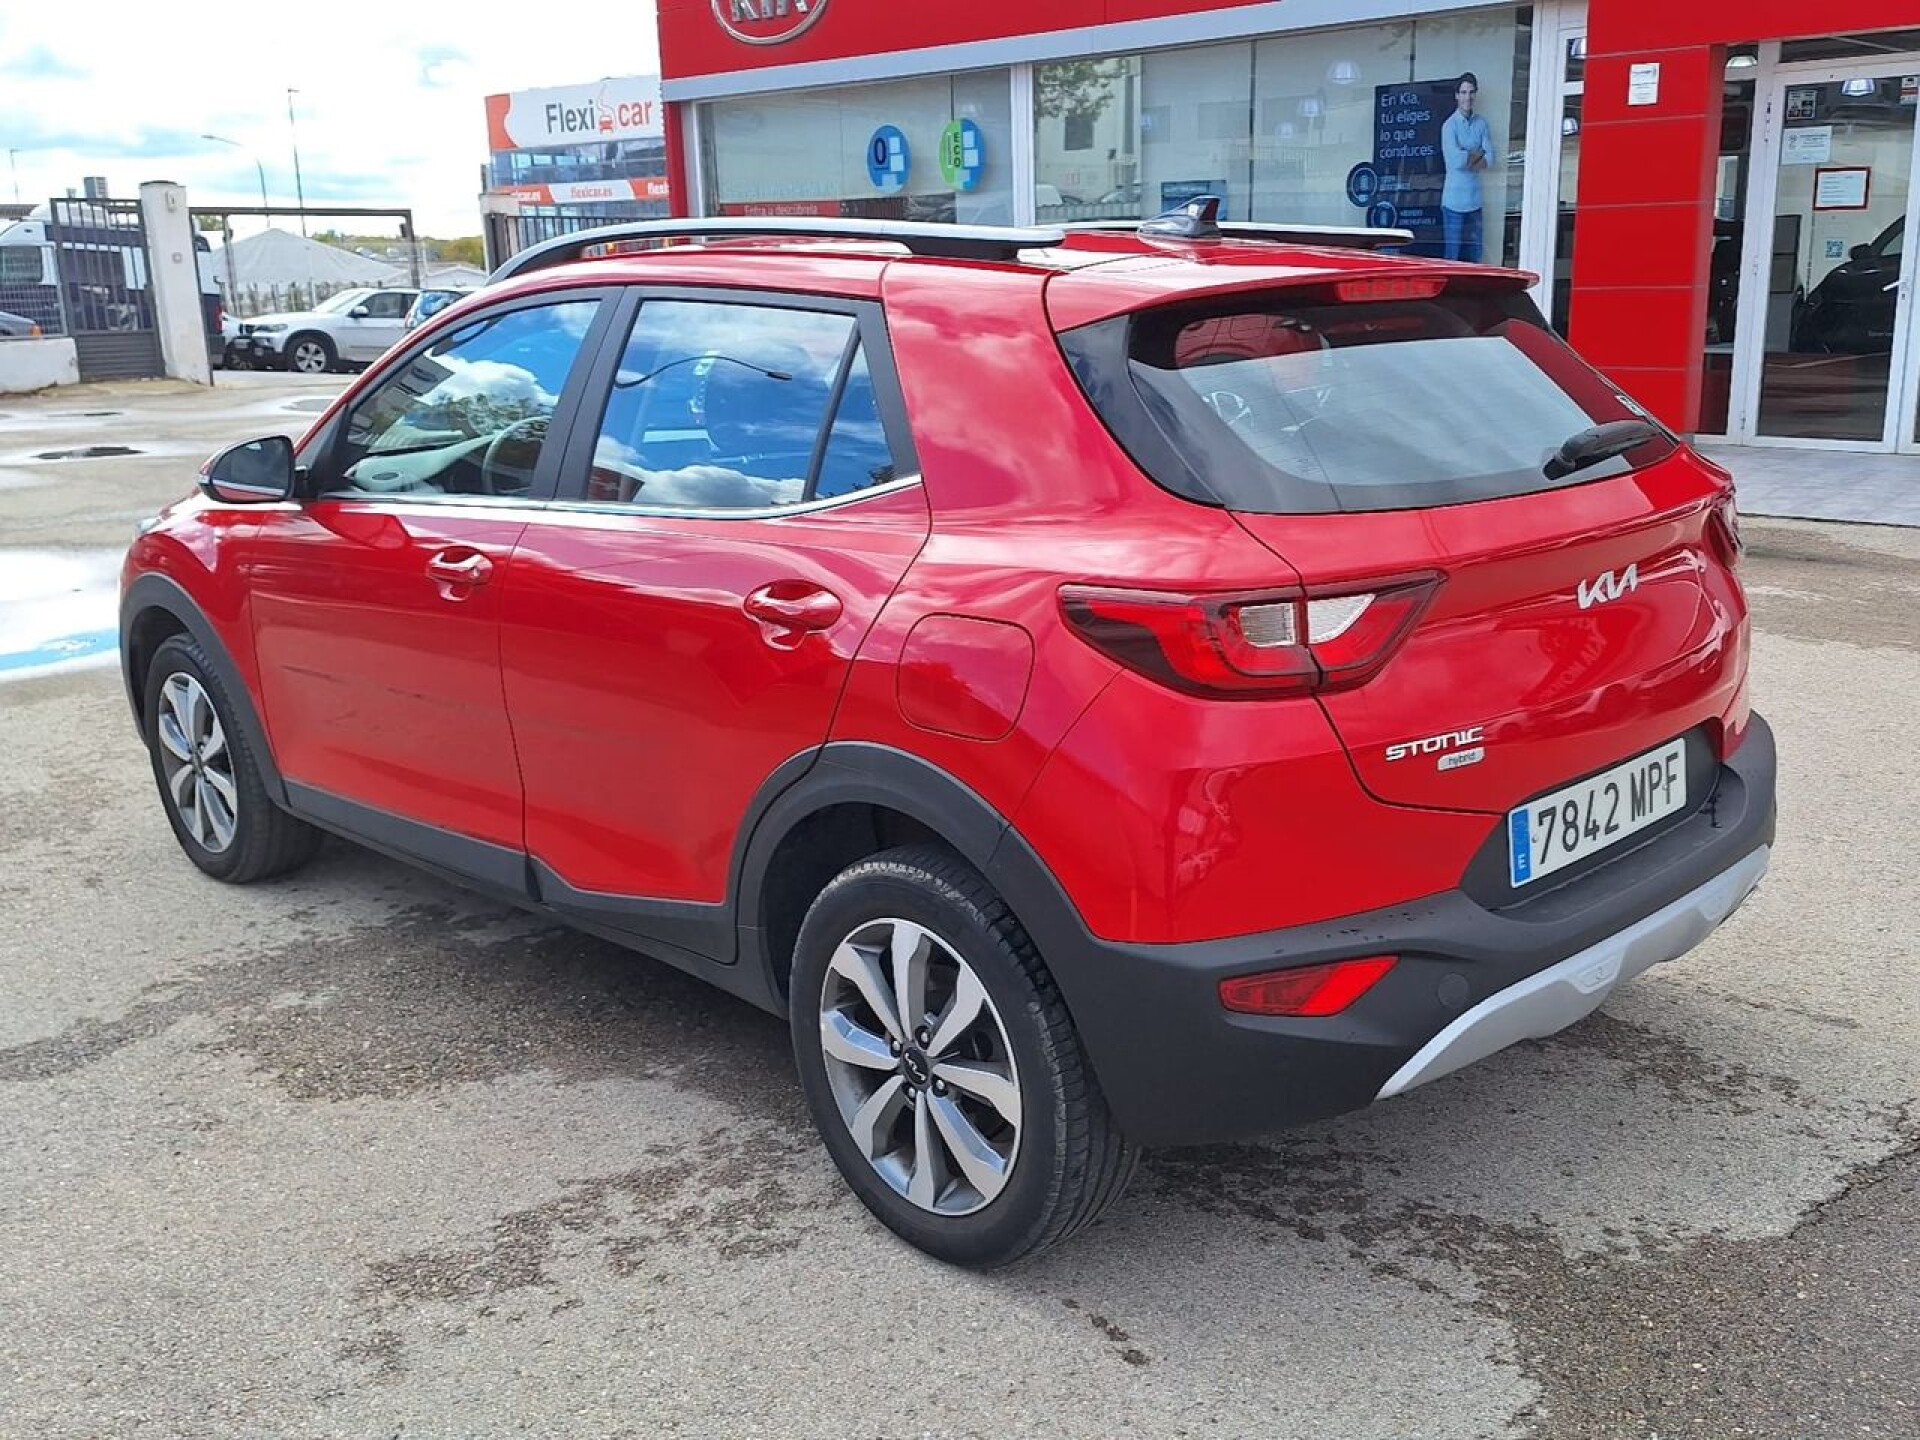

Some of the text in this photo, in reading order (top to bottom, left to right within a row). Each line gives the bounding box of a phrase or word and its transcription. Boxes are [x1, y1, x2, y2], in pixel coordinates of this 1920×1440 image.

[545, 98, 652, 133] Flexi car
[1381, 94, 1396, 107] En
[1381, 108, 1431, 125] tú eliges
[953, 132, 961, 168] ECO
[1380, 128, 1416, 142] lo que
[1578, 563, 1638, 609] KIA
[1386, 726, 1485, 761] STONIC
[1448, 751, 1477, 766] hybrid
[1517, 752, 1679, 870] E 7842 MPF
